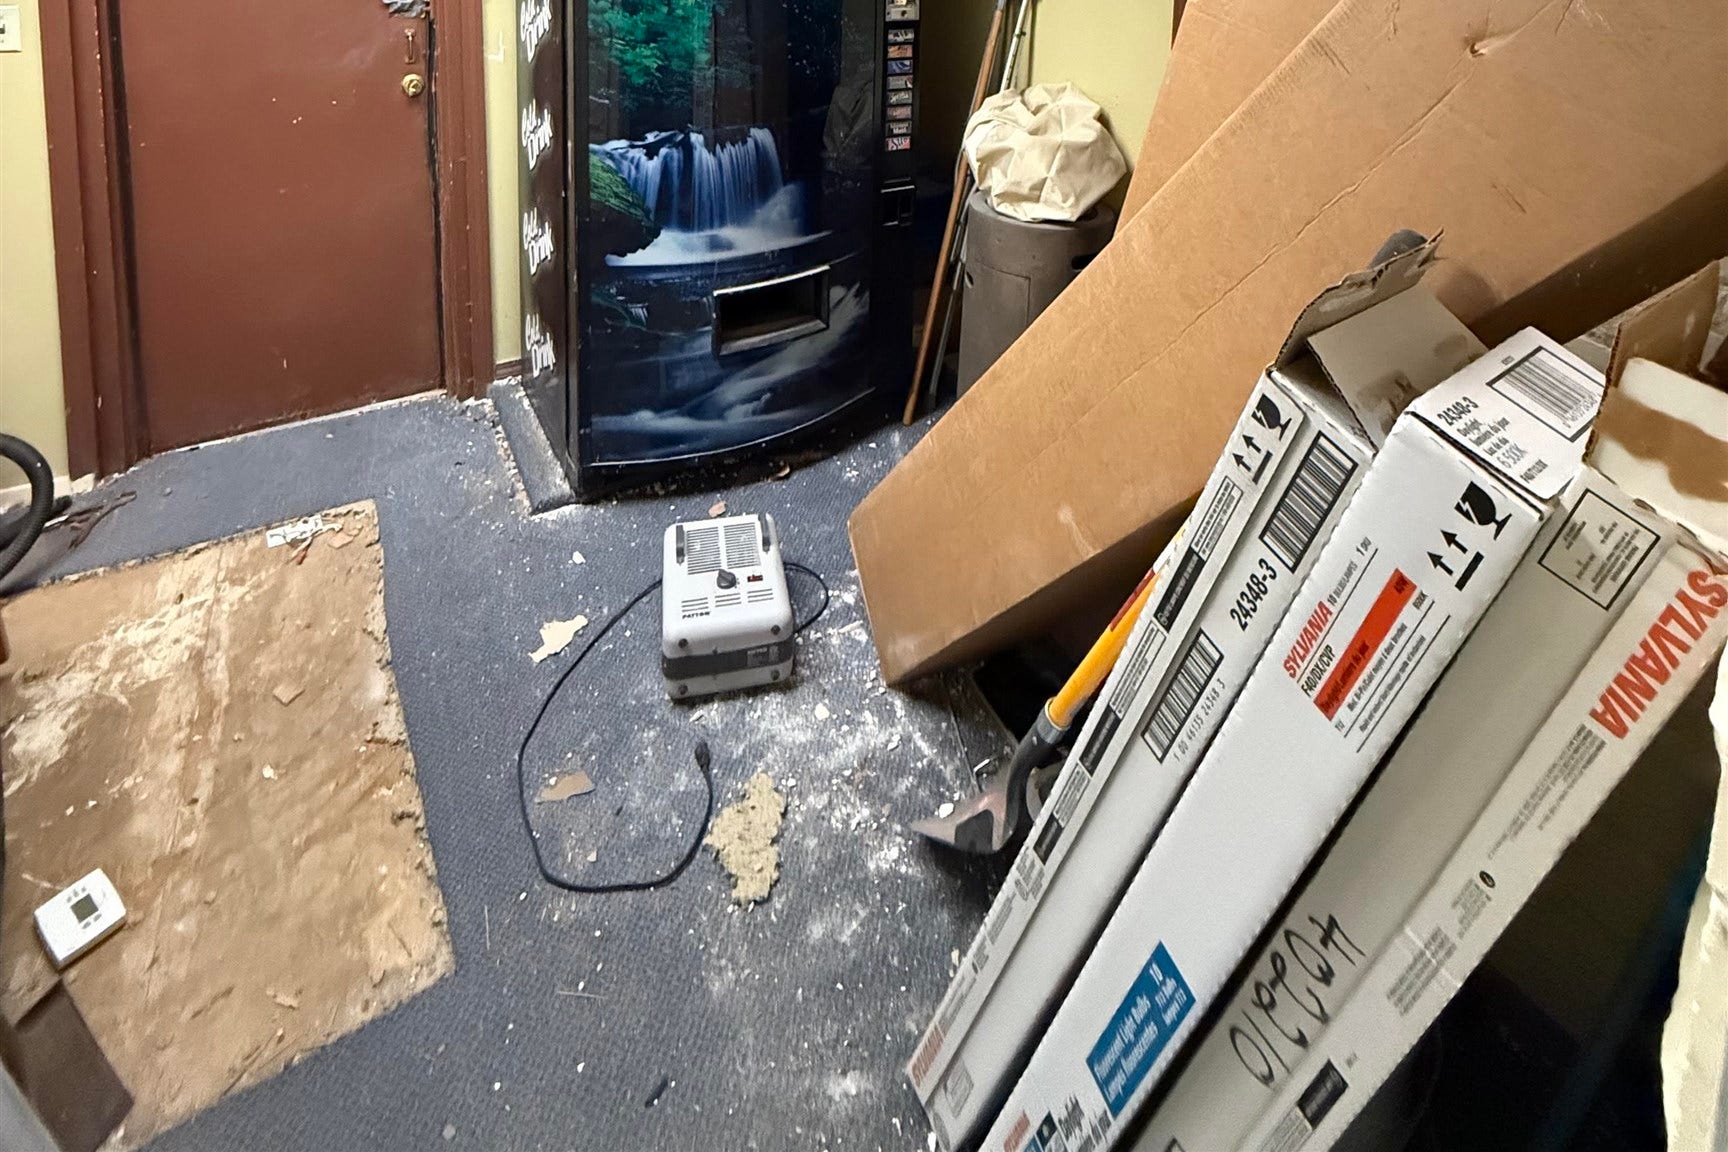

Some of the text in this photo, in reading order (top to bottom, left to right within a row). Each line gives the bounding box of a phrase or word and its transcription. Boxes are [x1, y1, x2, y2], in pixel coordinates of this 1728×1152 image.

[528, 109, 553, 170] Drink
[529, 223, 554, 276] Drink
[531, 332, 556, 378] Drink
[1437, 396, 1479, 426] 24348-3
[1230, 558, 1277, 631] 24348-3
[1283, 600, 1333, 679] SYLVANIA
[1327, 593, 1337, 607] 10
[1588, 569, 1728, 739] SYLVANIA
[1301, 644, 1336, 698] F40/DX/CVP
[1150, 962, 1163, 986] 10
